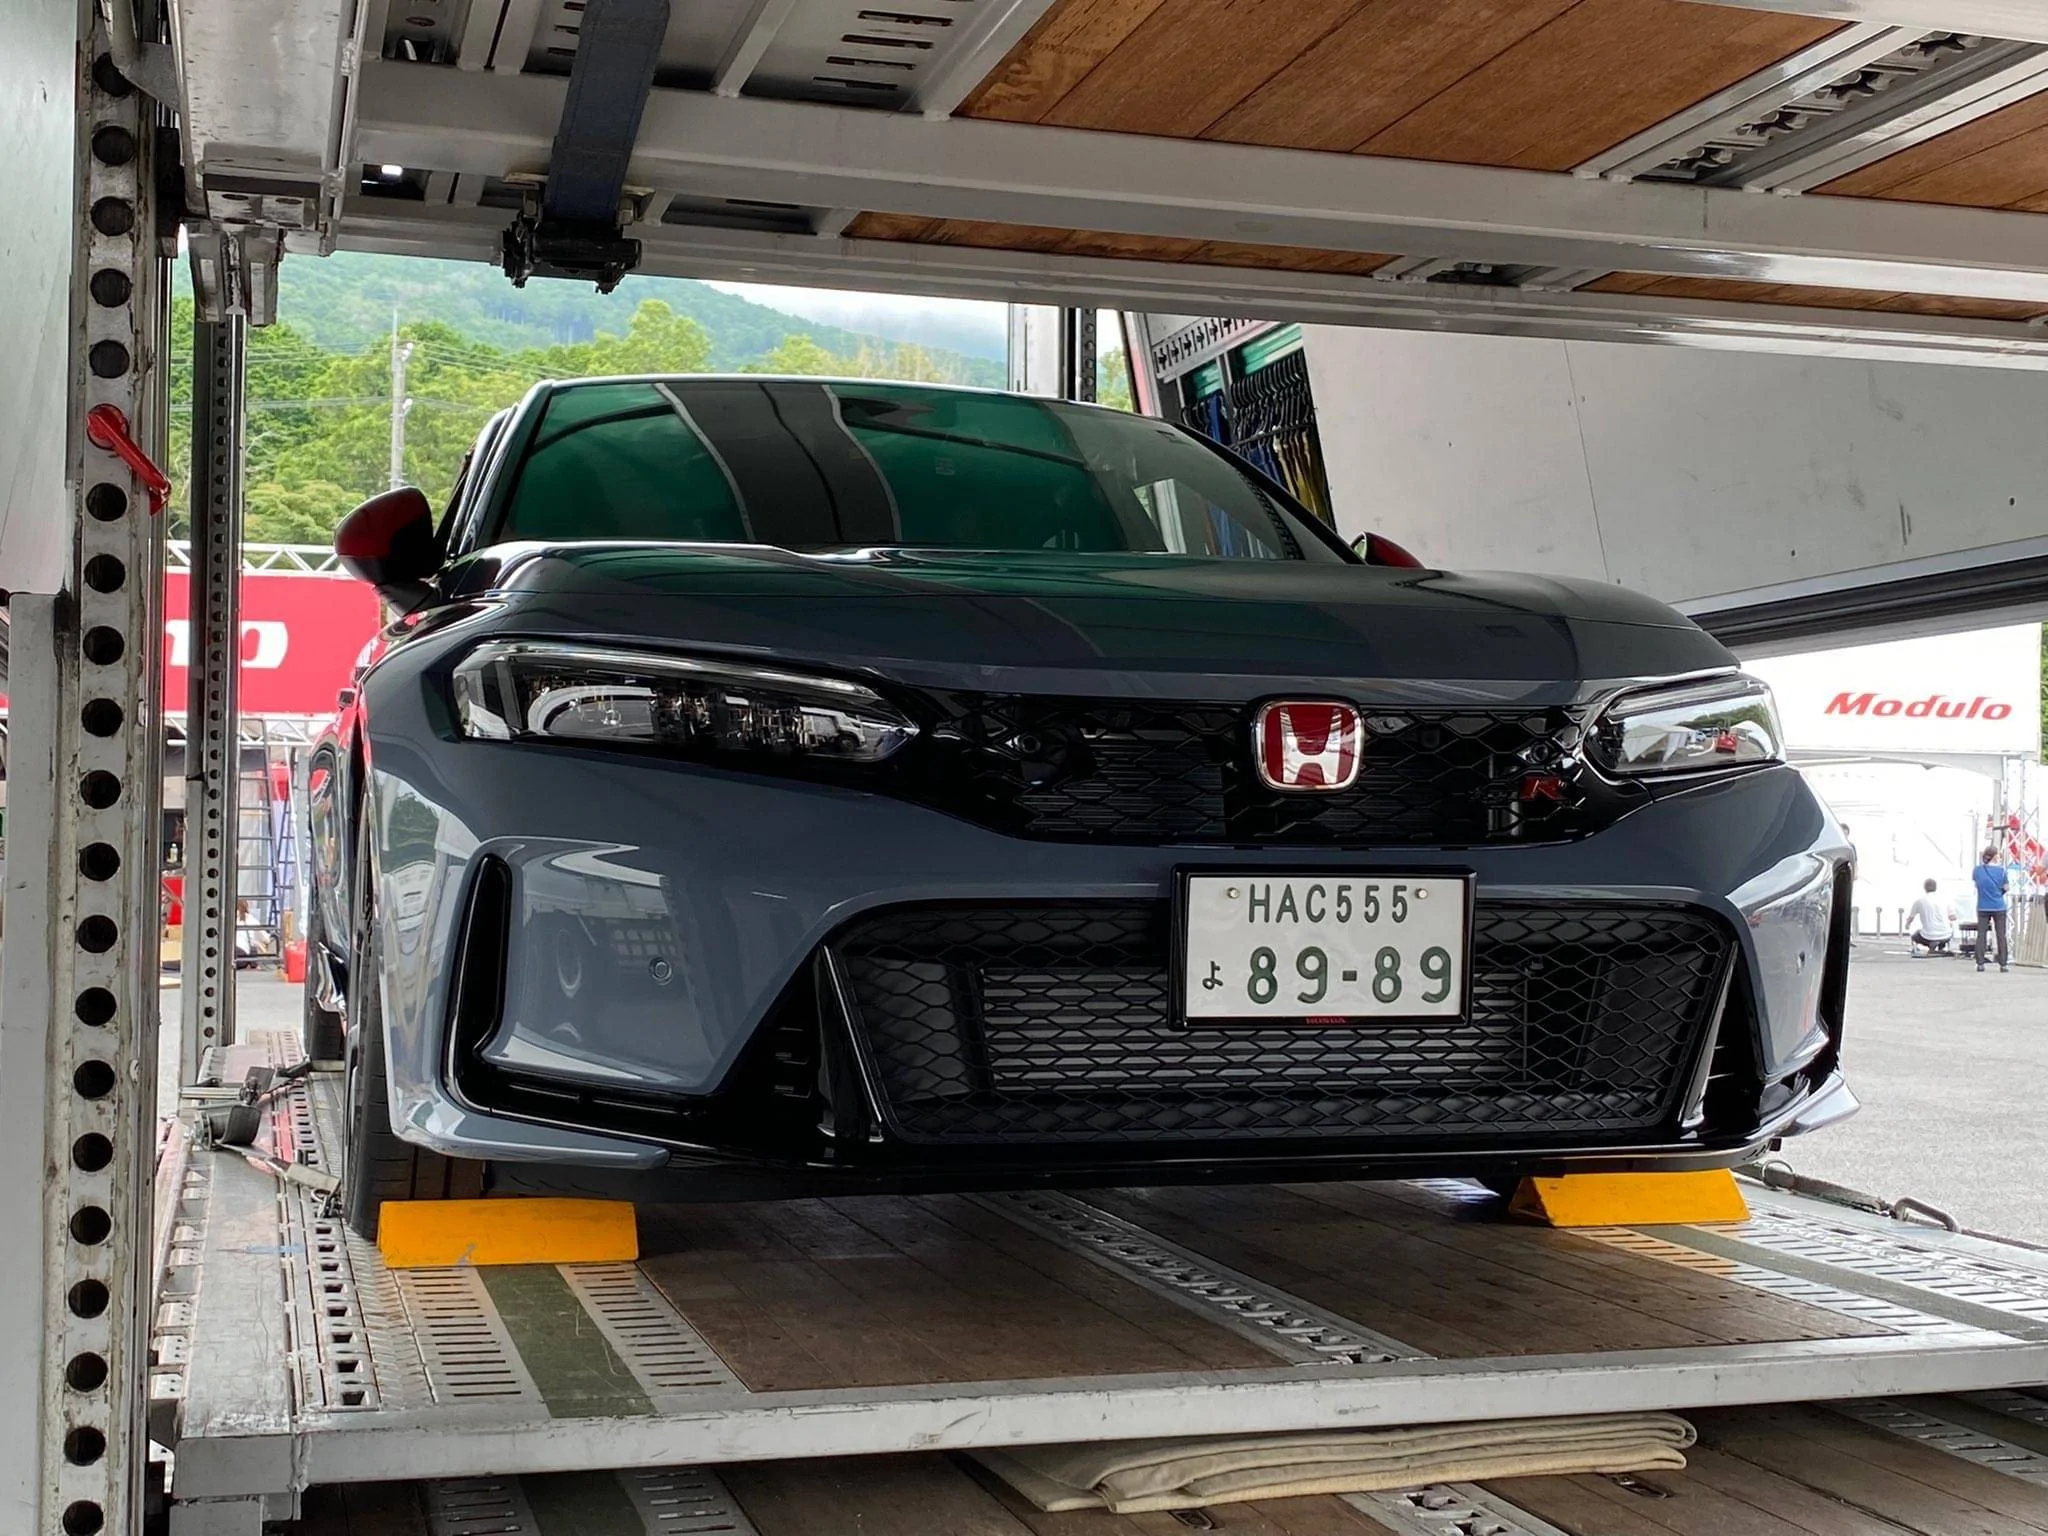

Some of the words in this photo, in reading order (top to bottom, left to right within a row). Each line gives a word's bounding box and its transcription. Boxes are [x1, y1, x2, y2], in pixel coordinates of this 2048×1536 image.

[1824, 693, 2012, 720] Modulo
[1248, 883, 1408, 923] HAC555
[1202, 960, 1223, 990] よ
[1247, 946, 1452, 1004] 89-89
